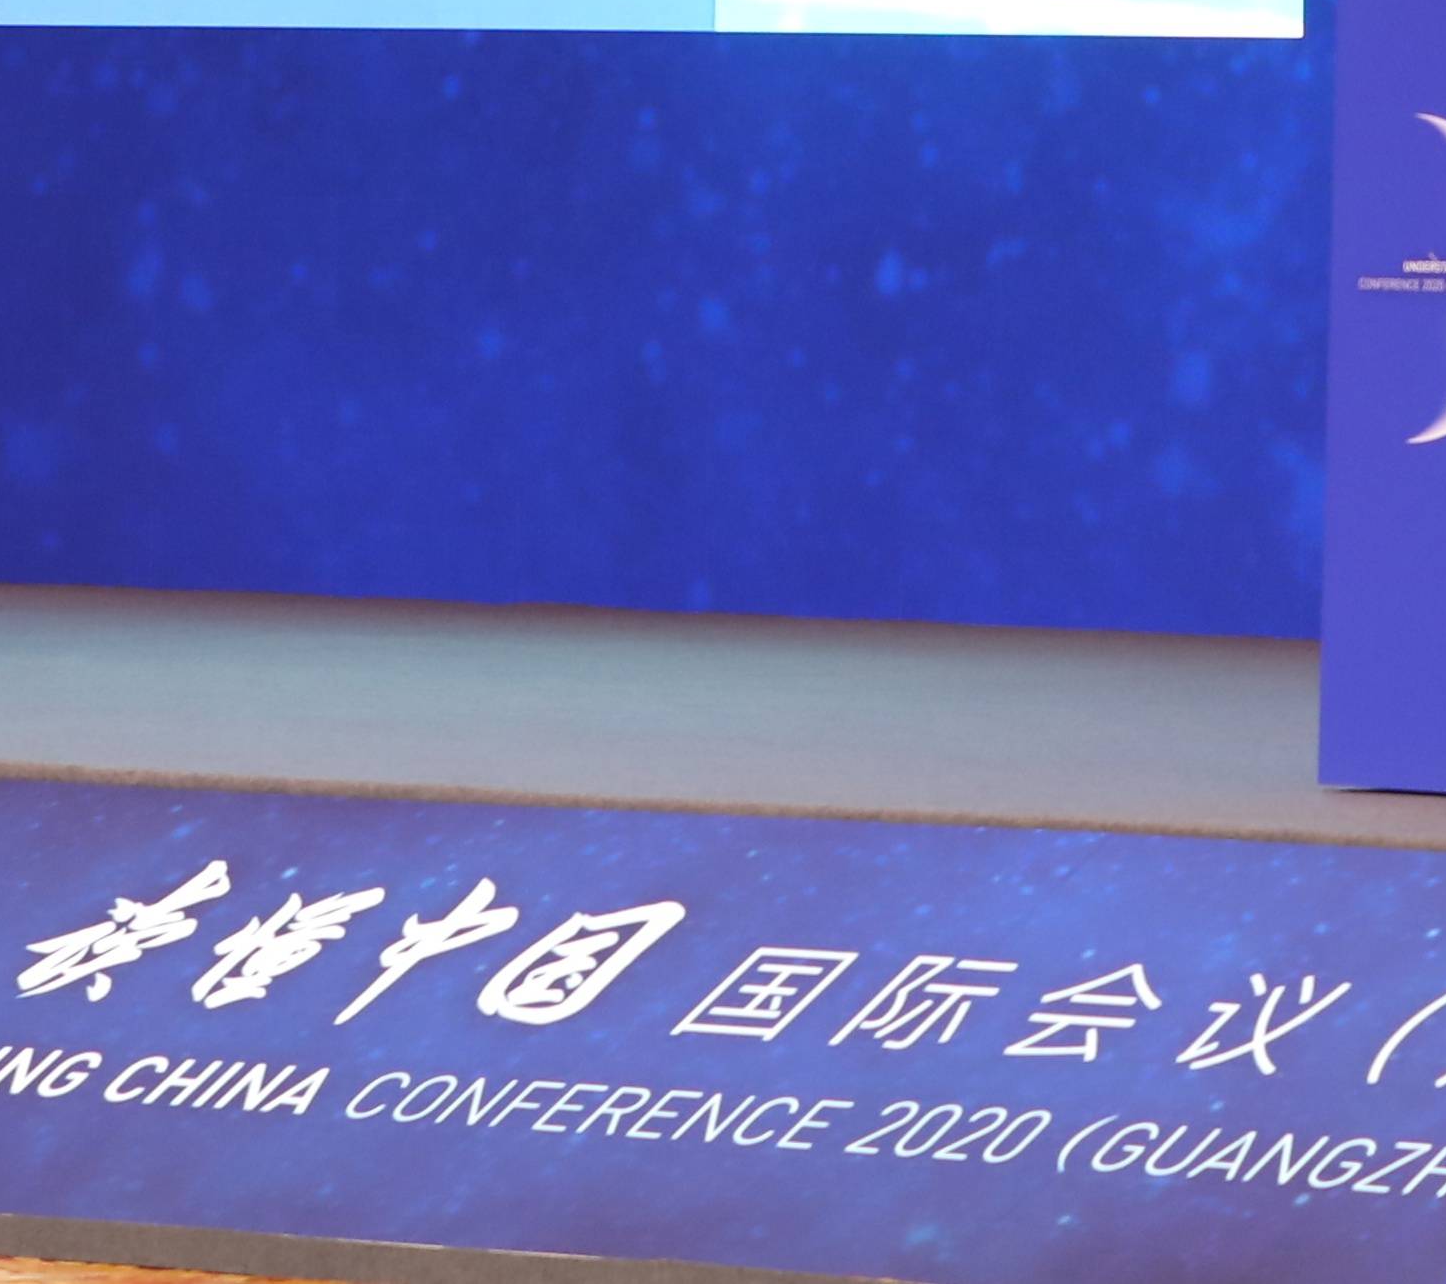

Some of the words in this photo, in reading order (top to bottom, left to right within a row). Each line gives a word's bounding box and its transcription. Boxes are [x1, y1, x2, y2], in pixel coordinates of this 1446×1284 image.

[103, 1054, 331, 1116] CHINA
[344, 1071, 855, 1151] CONFERENCE
[844, 1099, 1053, 1164] 2020
